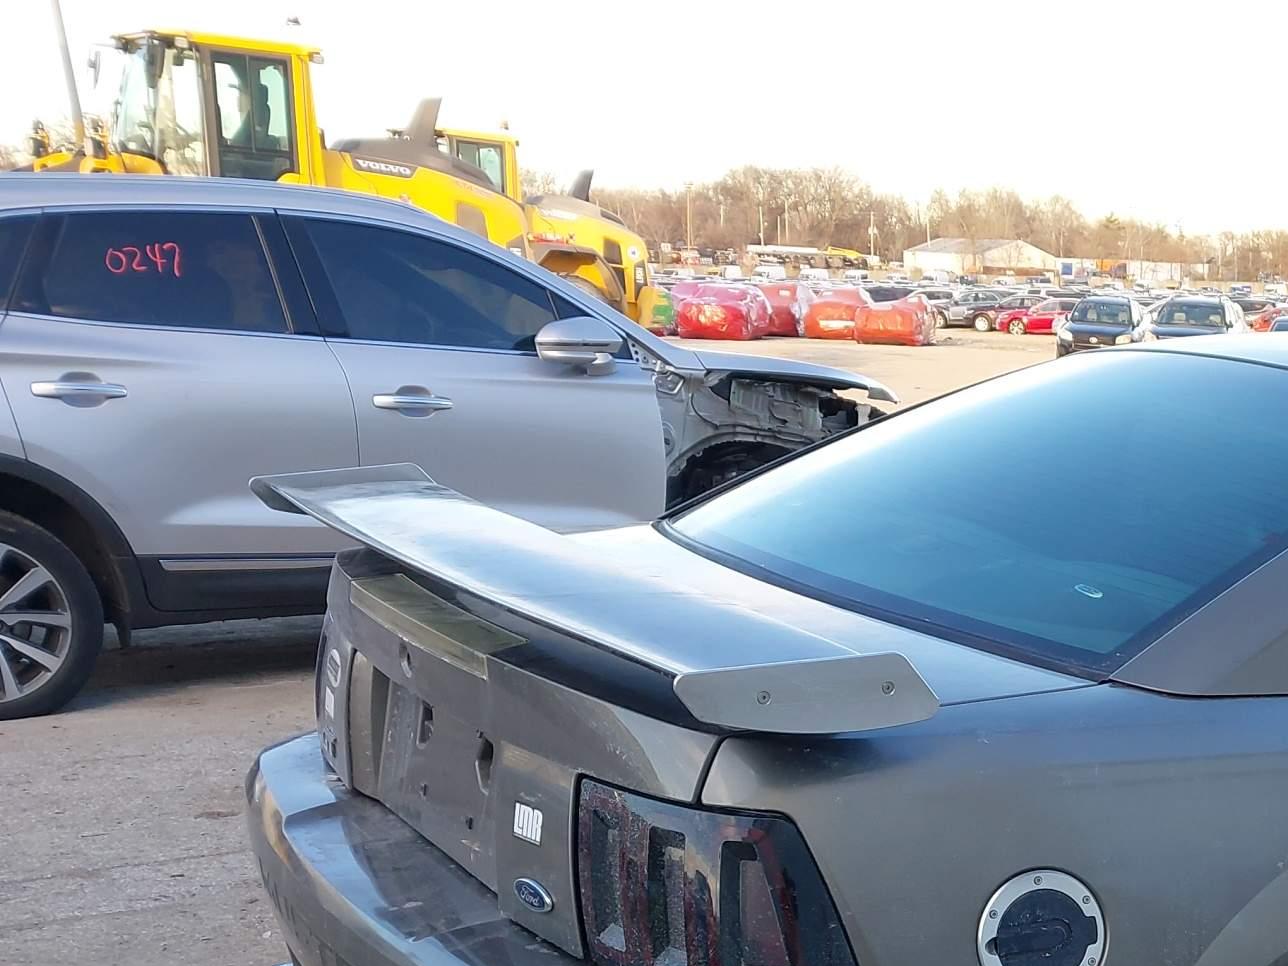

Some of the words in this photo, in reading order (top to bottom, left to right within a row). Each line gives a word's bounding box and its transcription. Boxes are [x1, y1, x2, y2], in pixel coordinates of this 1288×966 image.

[354, 158, 411, 175] VOLVO
[105, 242, 180, 277] 0247
[513, 801, 543, 845] LMR
